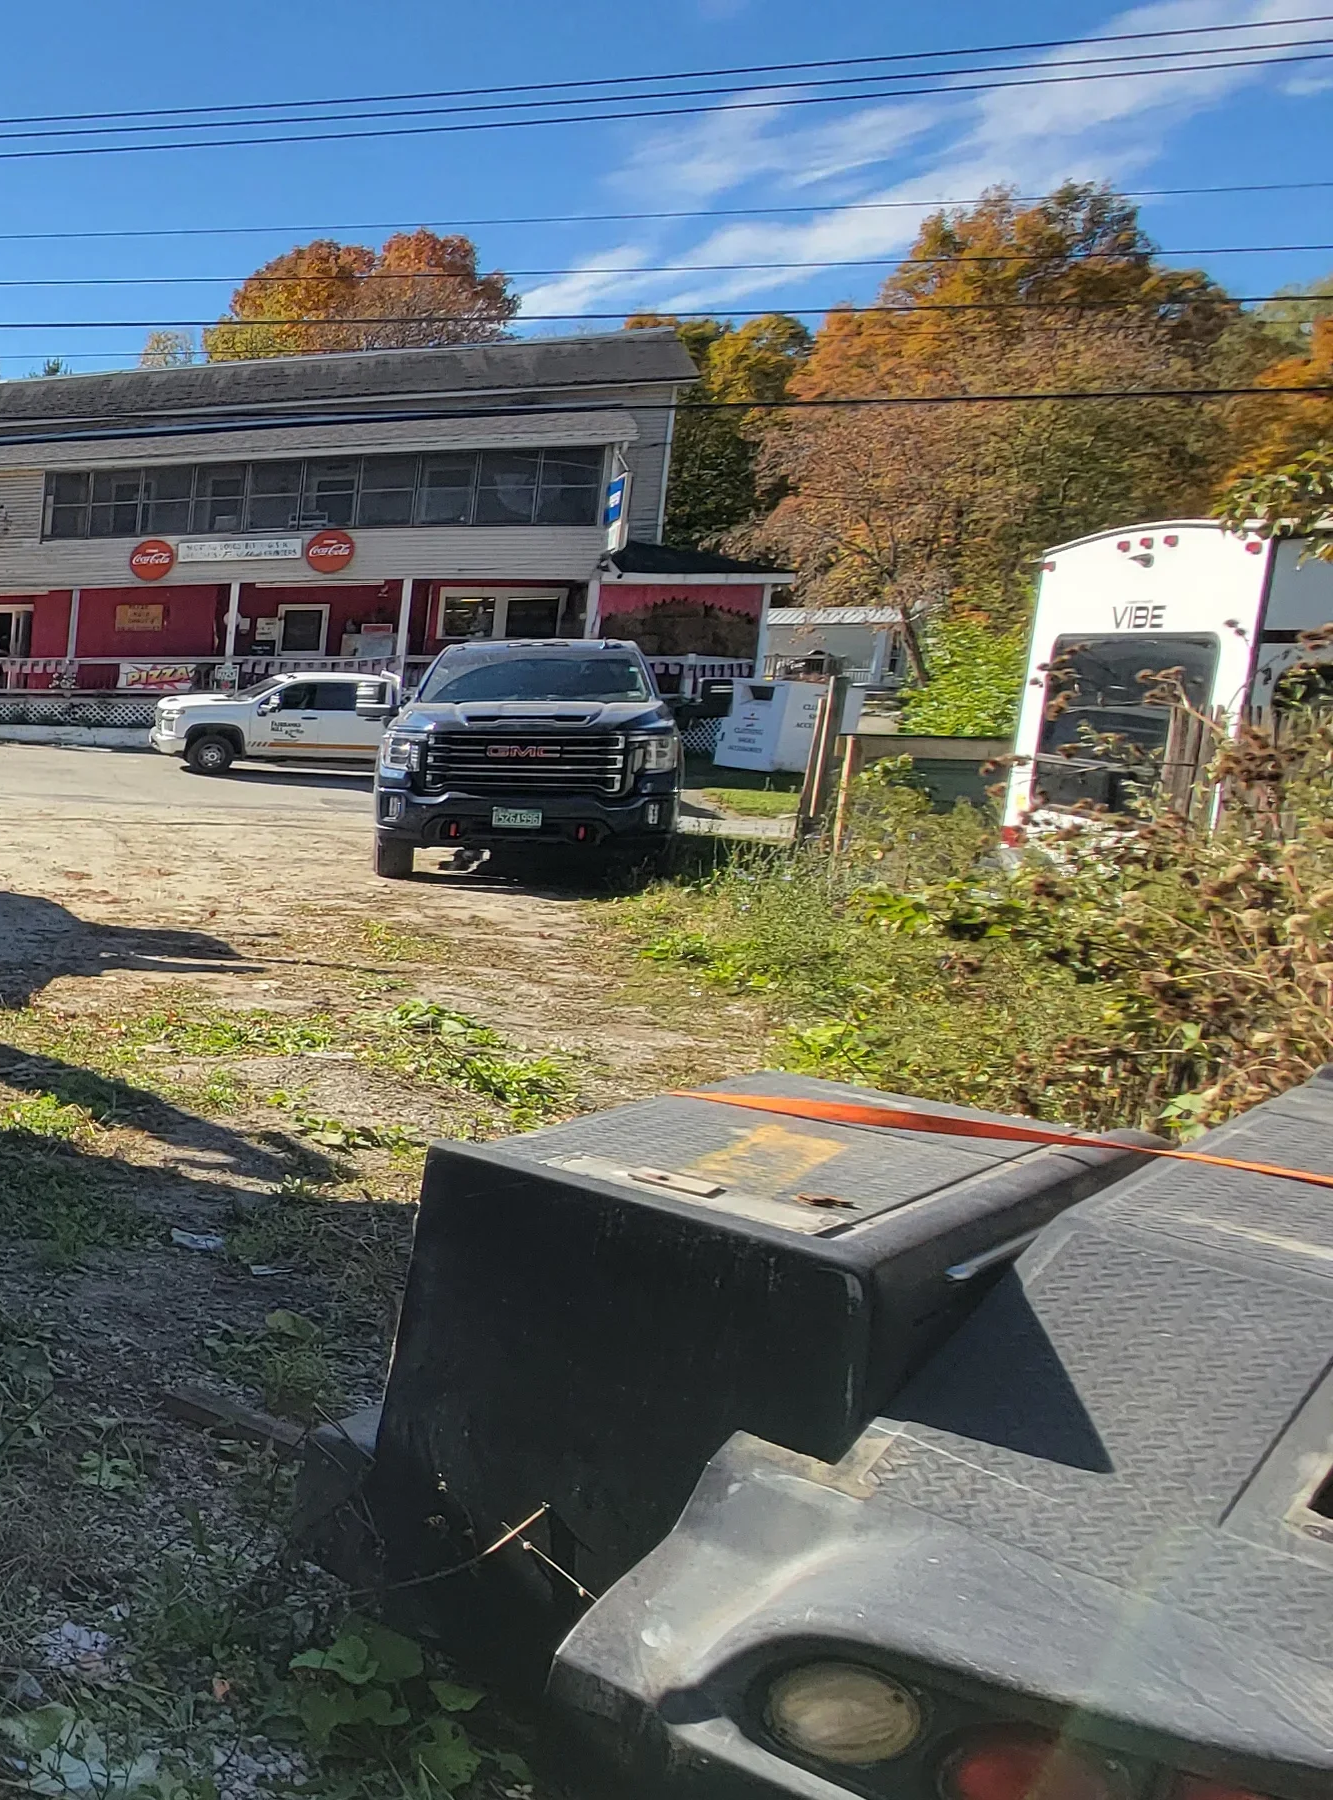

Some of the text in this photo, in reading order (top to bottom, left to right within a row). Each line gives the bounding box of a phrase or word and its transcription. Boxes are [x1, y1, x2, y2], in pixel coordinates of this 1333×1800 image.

[1112, 605, 1167, 629] VIBE
[127, 666, 190, 686] PIZZA
[487, 745, 561, 757] GMC
